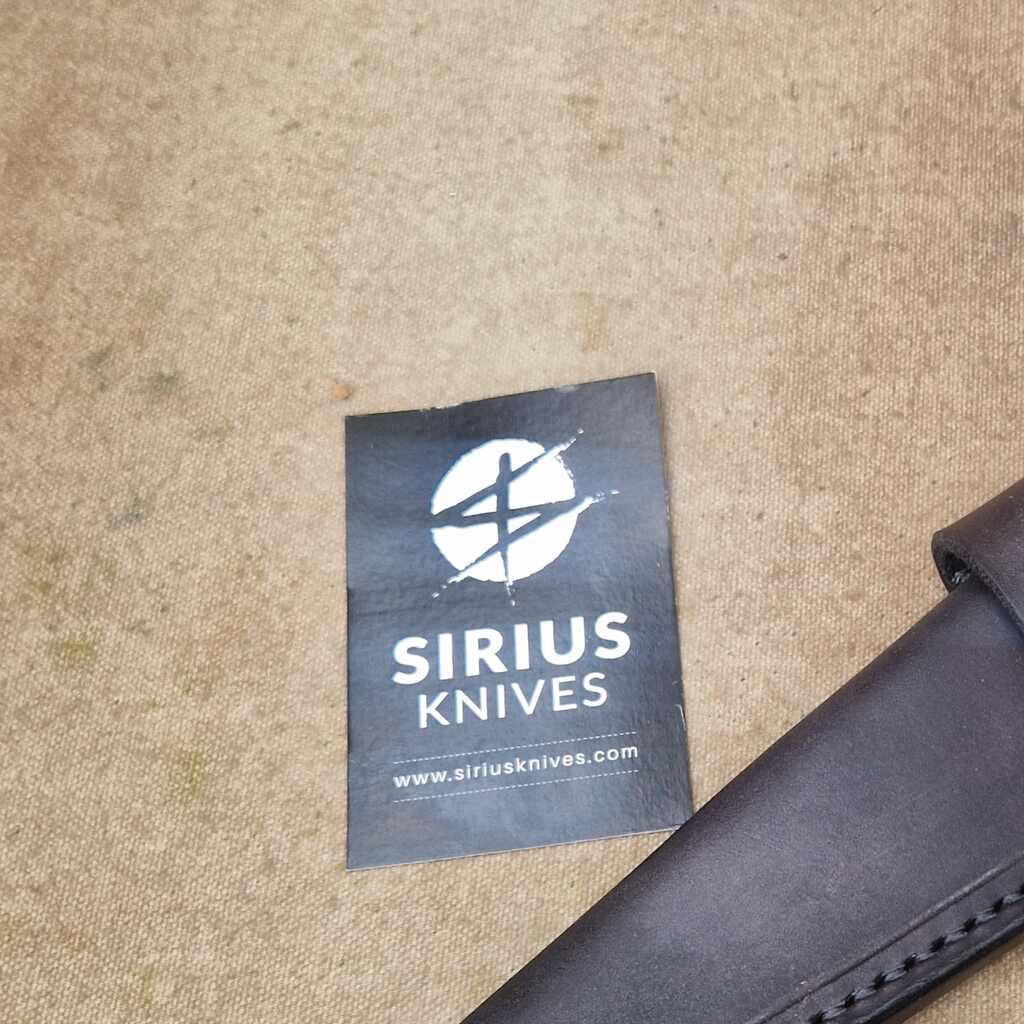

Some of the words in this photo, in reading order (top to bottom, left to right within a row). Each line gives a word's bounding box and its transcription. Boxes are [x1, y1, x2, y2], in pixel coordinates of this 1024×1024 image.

[392, 611, 631, 685] SIRIUS
[418, 672, 608, 729] KNIVES
[393, 745, 638, 788] www.siriusknives.com
